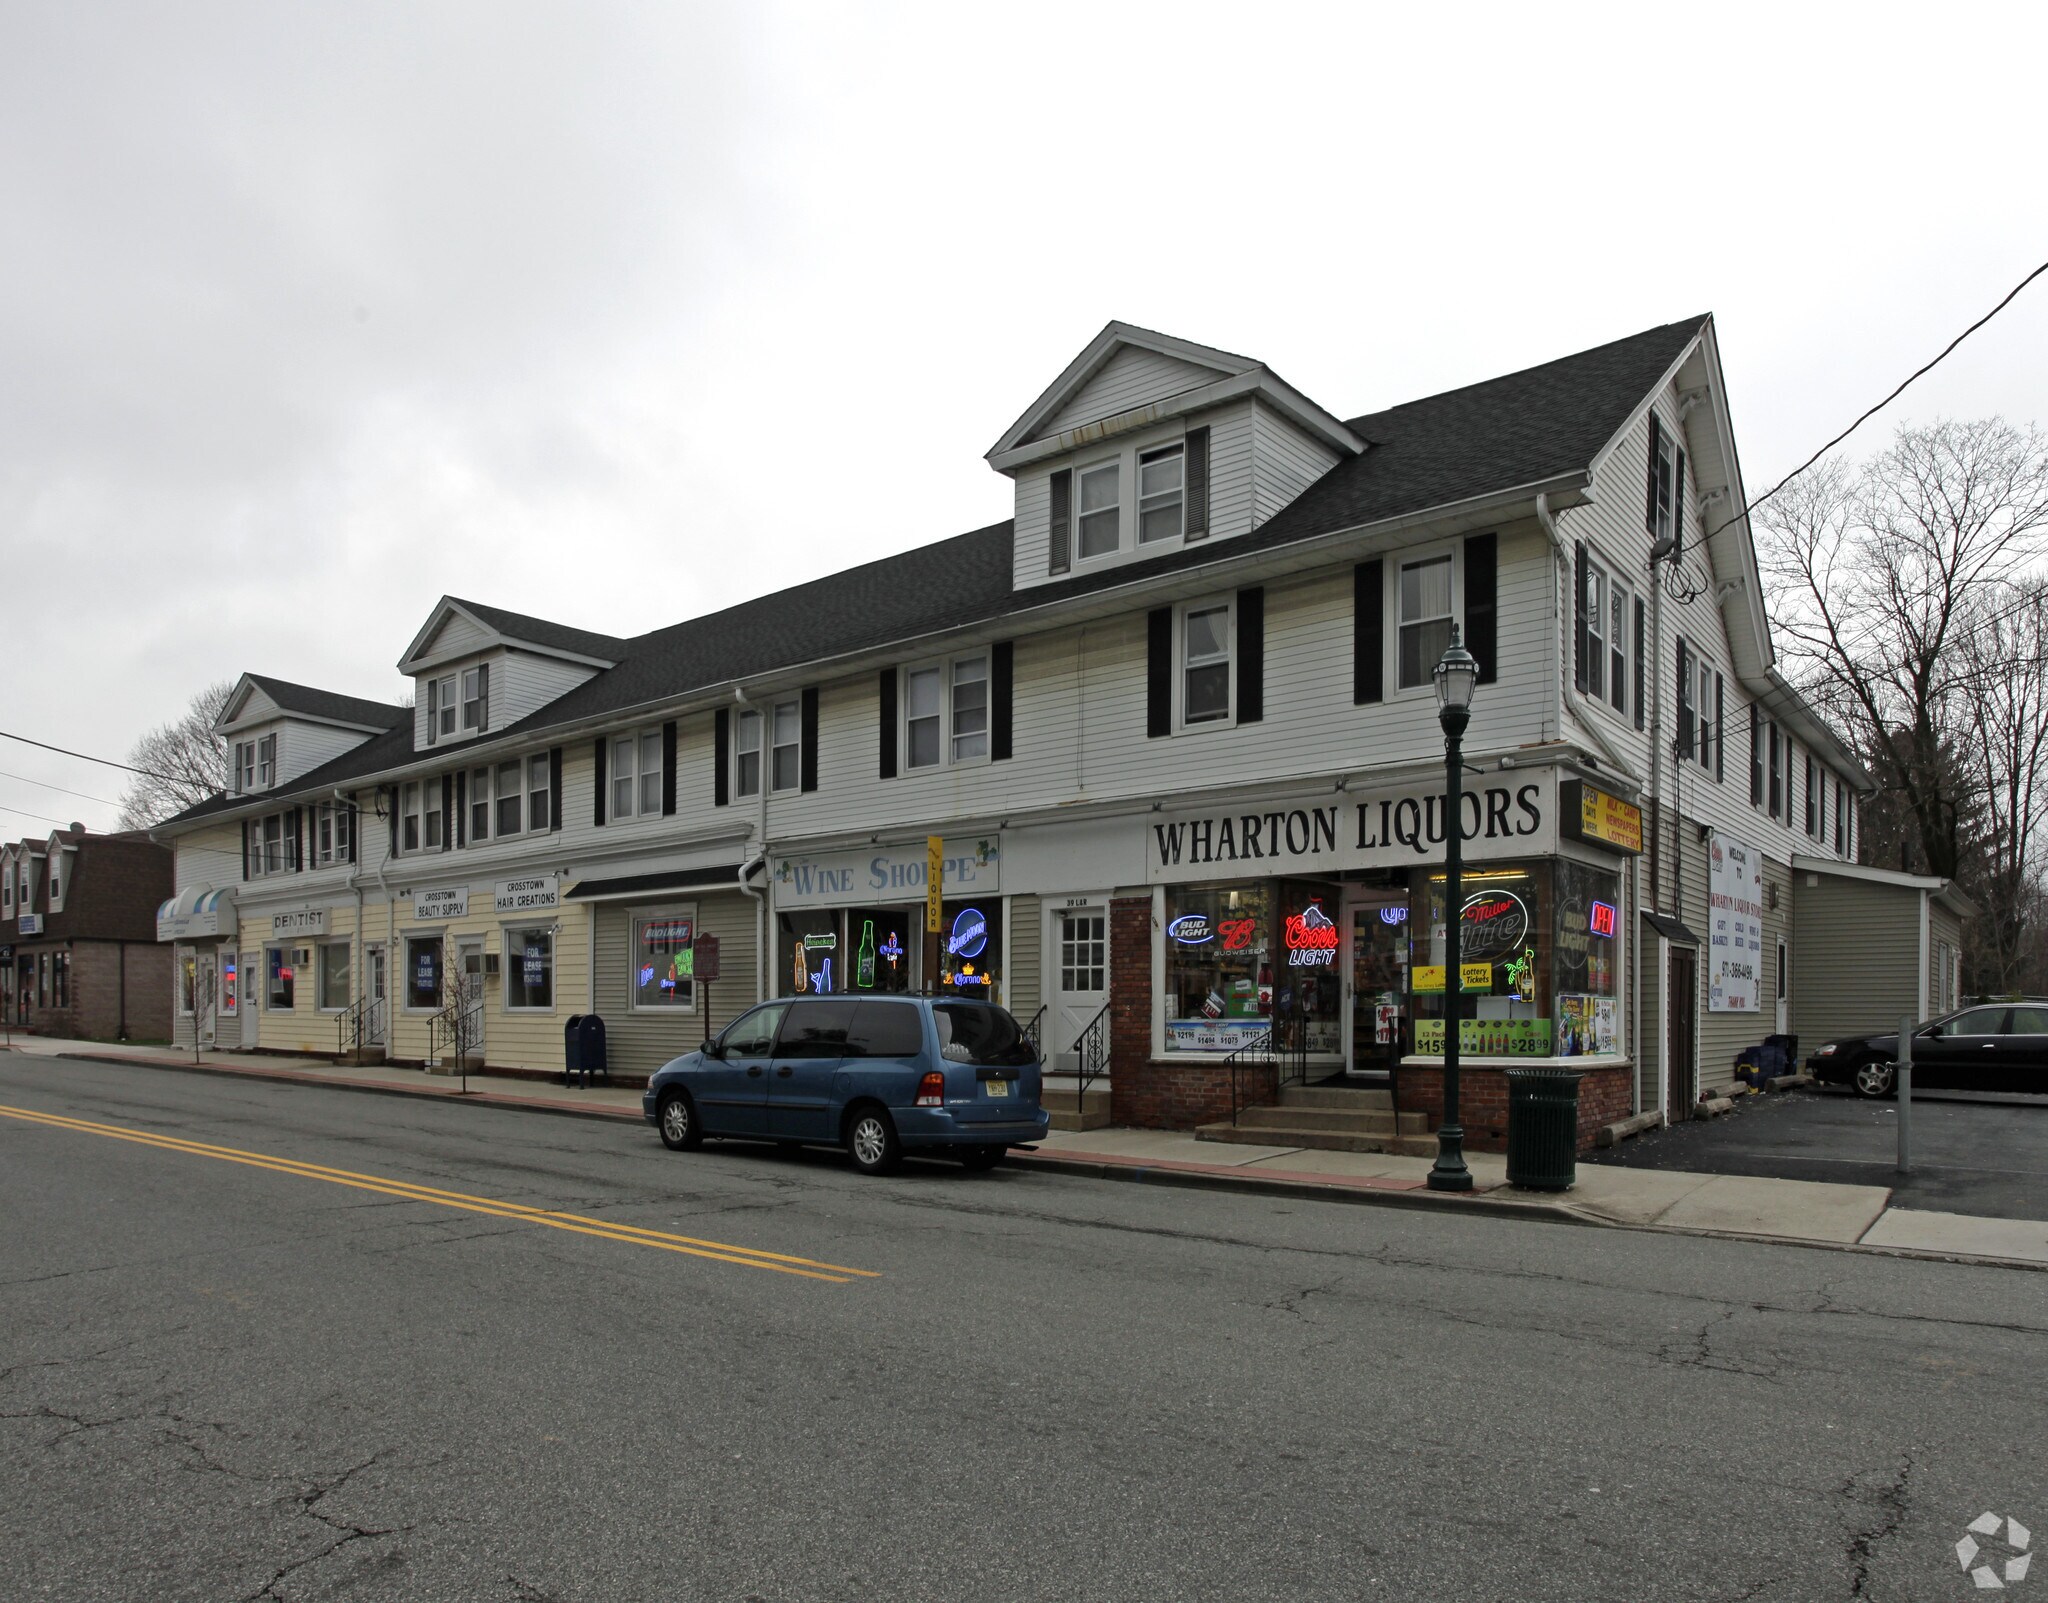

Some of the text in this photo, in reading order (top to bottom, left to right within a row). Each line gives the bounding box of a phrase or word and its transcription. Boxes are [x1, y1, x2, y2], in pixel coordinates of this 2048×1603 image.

[1153, 784, 1541, 866] WHARTON LIQUORS
[1606, 813, 1640, 836] NEWSPAPERS
[1607, 828, 1640, 849] LOTTERY
[1729, 846, 1746, 865] WELCOME
[1736, 866, 1742, 880] TO
[507, 880, 545, 892] CROSSTOWN
[425, 891, 457, 901] CROSSTOWN
[497, 892, 555, 909] HAIR CREATIONS
[418, 902, 464, 917] BEAUTY SUPPLY
[1466, 900, 1515, 923] Miller
[1711, 892, 1762, 919] WHARTON LIQUOR STORE
[274, 911, 323, 928] DENTIST
[1179, 920, 1206, 929] BUD
[1564, 911, 1587, 931] BUD
[1593, 904, 1612, 933] OPEN
[663, 927, 688, 937] LIGHT
[1175, 928, 1210, 938] LIGHT
[1285, 914, 1339, 949] Coors
[1460, 914, 1521, 954] Lite
[1735, 922, 1744, 933] COLD
[807, 938, 833, 947] Heineken
[1556, 930, 1590, 952] LIGHT
[1735, 936, 1744, 947] BEER
[527, 947, 540, 957] FOR
[1213, 948, 1267, 957] BUDWEISER
[1288, 949, 1336, 966] LIGHT
[420, 955, 431, 965] FOR
[523, 961, 542, 972] LEASE
[417, 968, 433, 977] LEASE
[953, 972, 982, 987] Corona
[1462, 968, 1487, 977] Lottery
[1466, 975, 1489, 984] Tickets
[1525, 1030, 1541, 1038] Case
[1511, 1038, 1549, 1053] $2899
